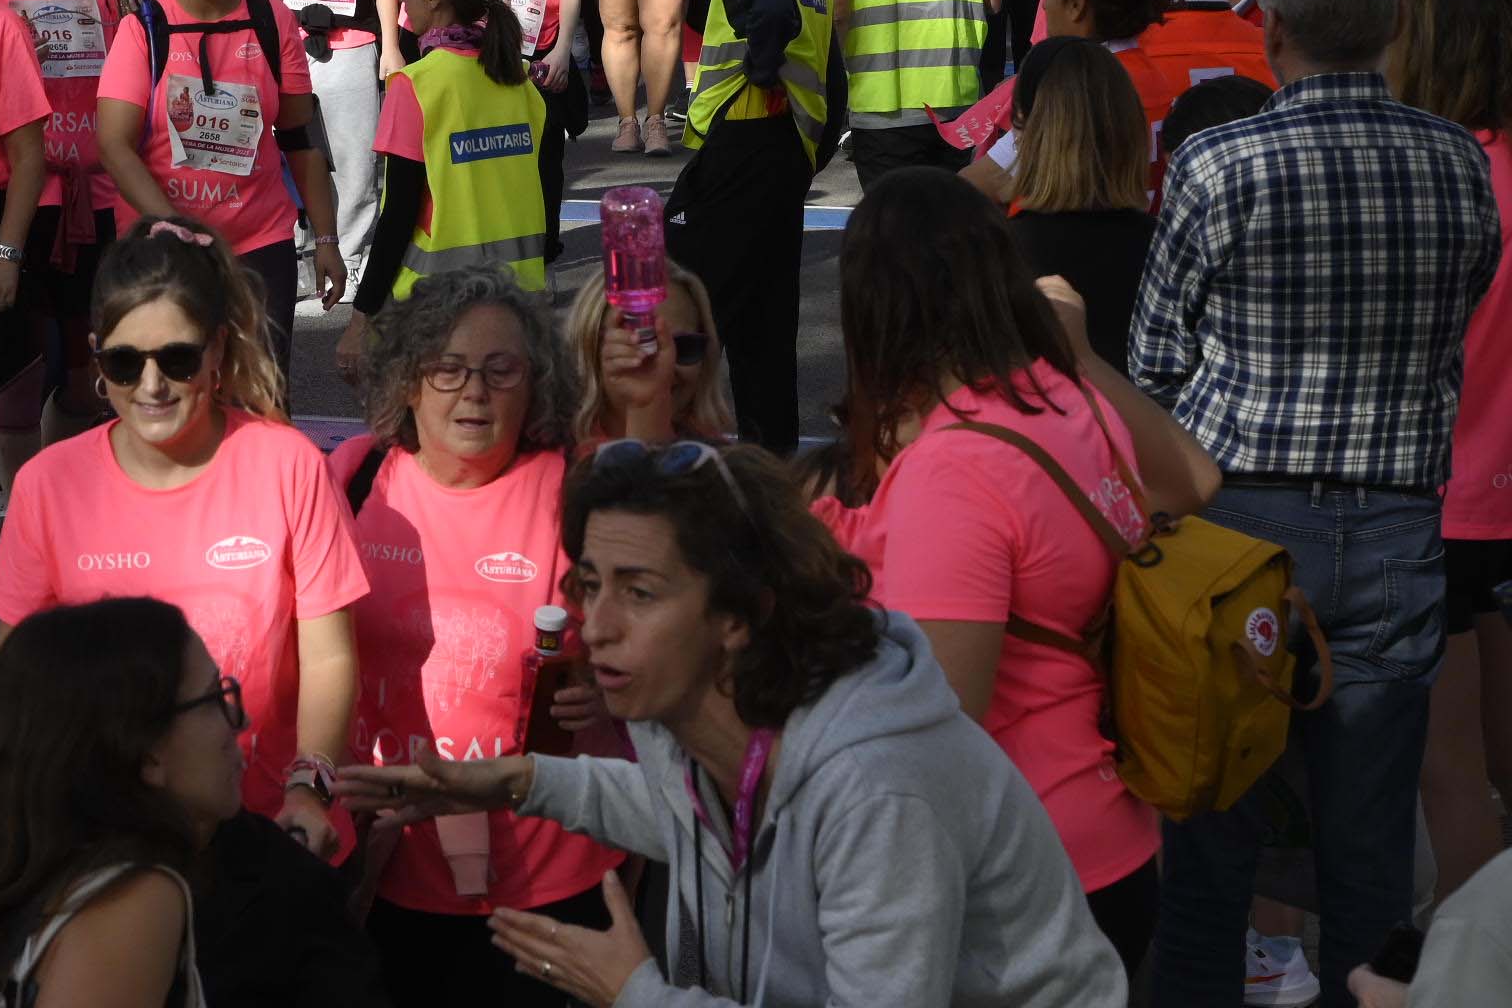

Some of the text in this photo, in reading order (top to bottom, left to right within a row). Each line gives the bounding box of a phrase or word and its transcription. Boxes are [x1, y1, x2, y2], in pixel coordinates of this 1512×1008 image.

[41, 29, 73, 41] 016
[197, 93, 236, 108] ASTURIANA
[195, 114, 230, 131] 016
[199, 131, 221, 142] 2658
[452, 127, 532, 156] VOLUNTARIS
[198, 142, 206, 150] DE
[215, 145, 235, 153] MUJER
[167, 178, 241, 202] SUMA
[76, 550, 151, 572] OYSHO
[207, 545, 271, 568] ASTURIANA
[358, 543, 423, 566] OYSHO
[477, 560, 537, 581] ASTURIANA
